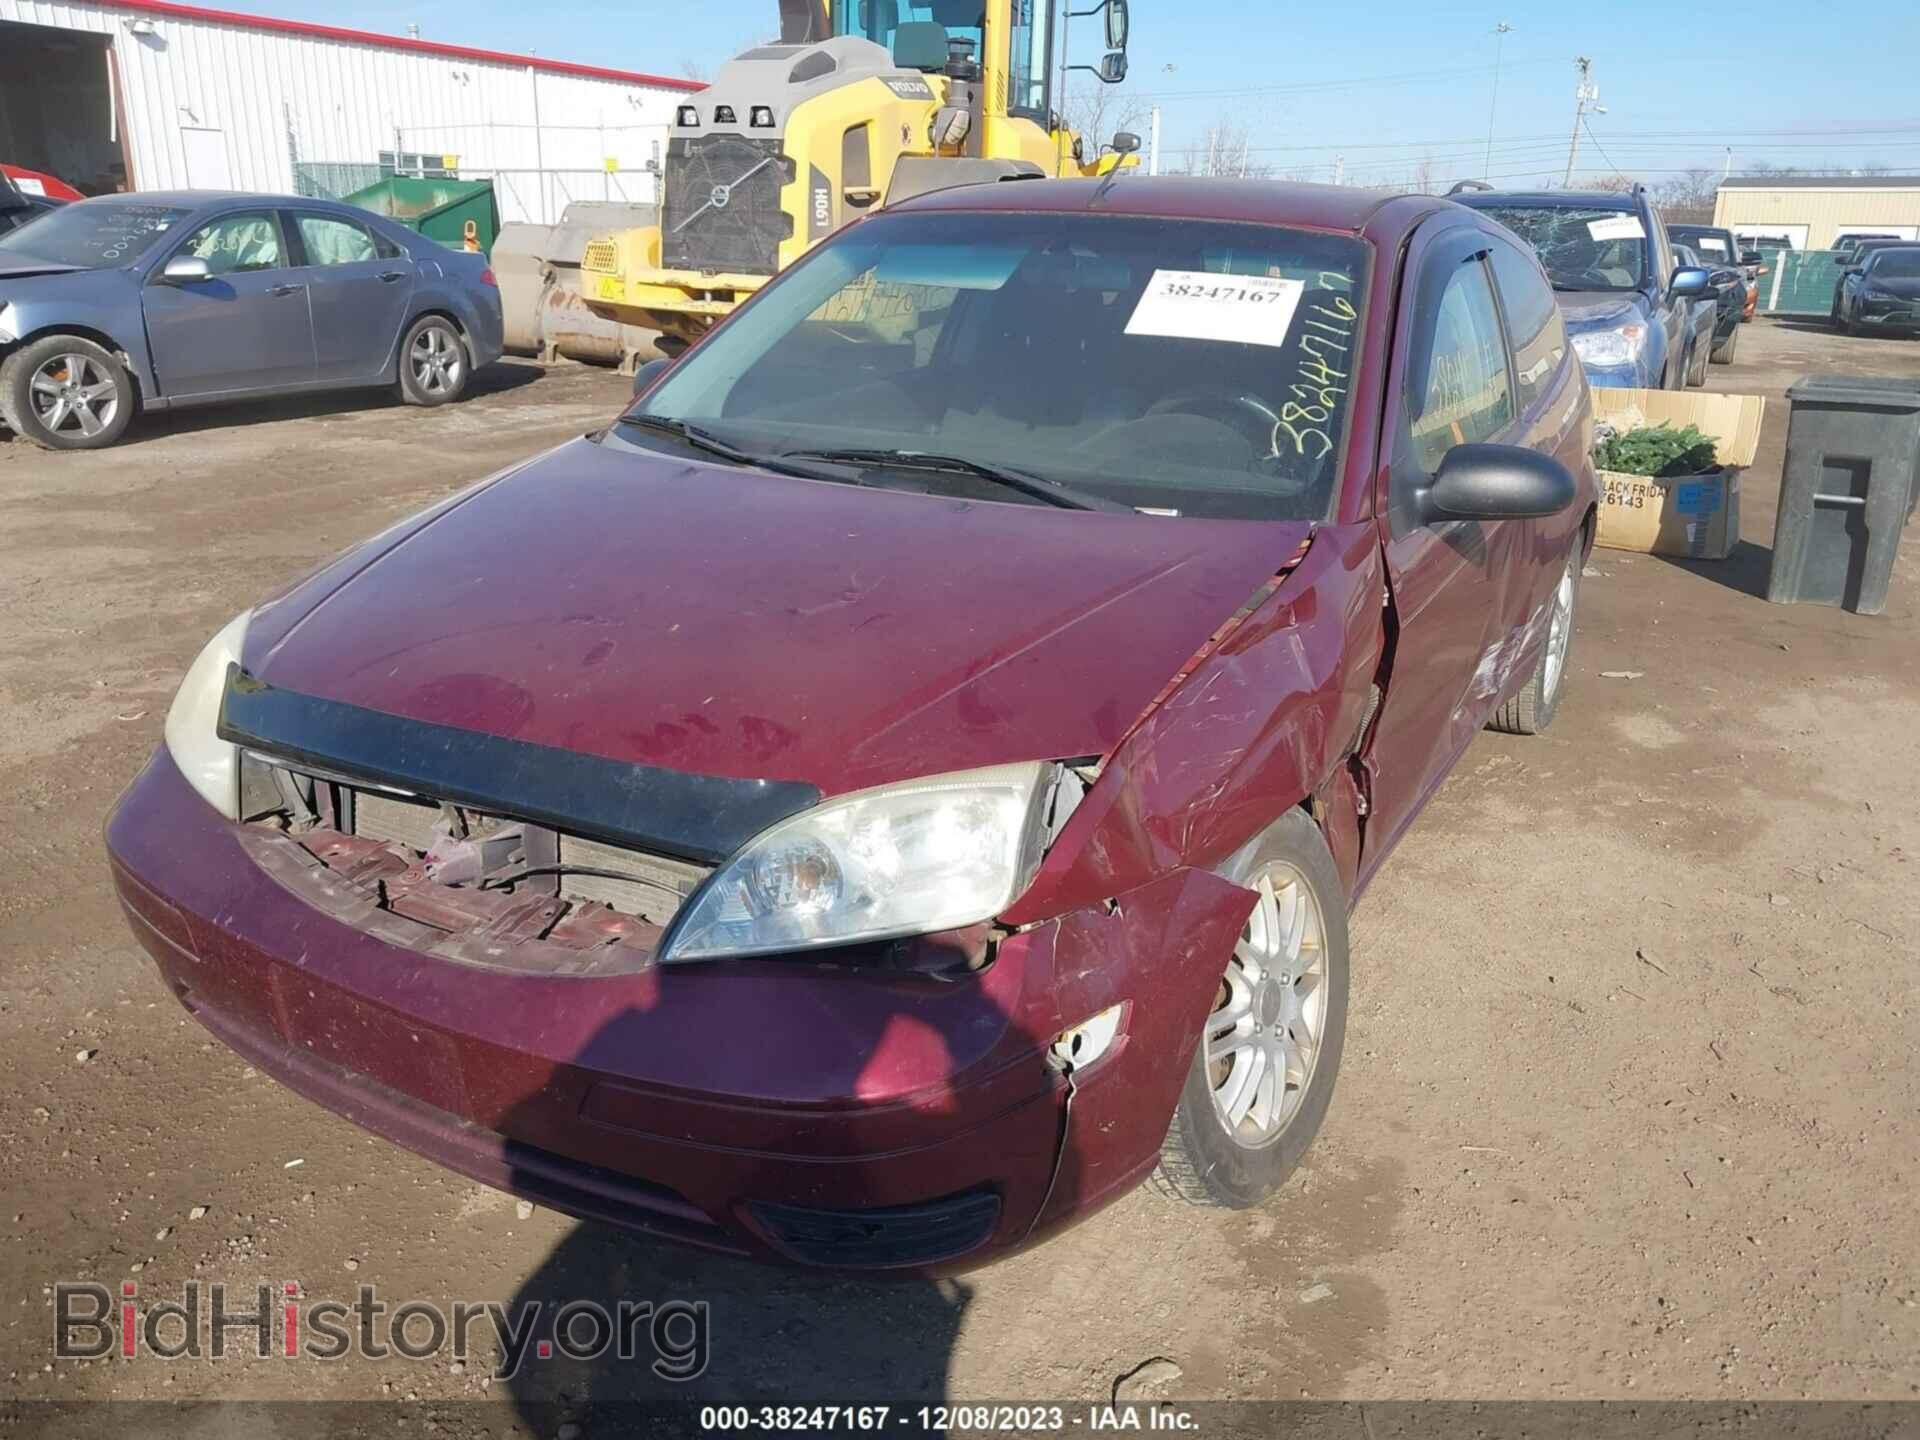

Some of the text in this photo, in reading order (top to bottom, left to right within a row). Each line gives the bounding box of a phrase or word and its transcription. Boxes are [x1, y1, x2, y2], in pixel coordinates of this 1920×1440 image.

[814, 187, 829, 227] L90H
[1160, 282, 1281, 304] 38247167
[1263, 271, 1357, 460] 38247167
[1602, 481, 1630, 495] LACK
[1632, 483, 1672, 498] FRIDAY
[1604, 492, 1644, 509] 6143
